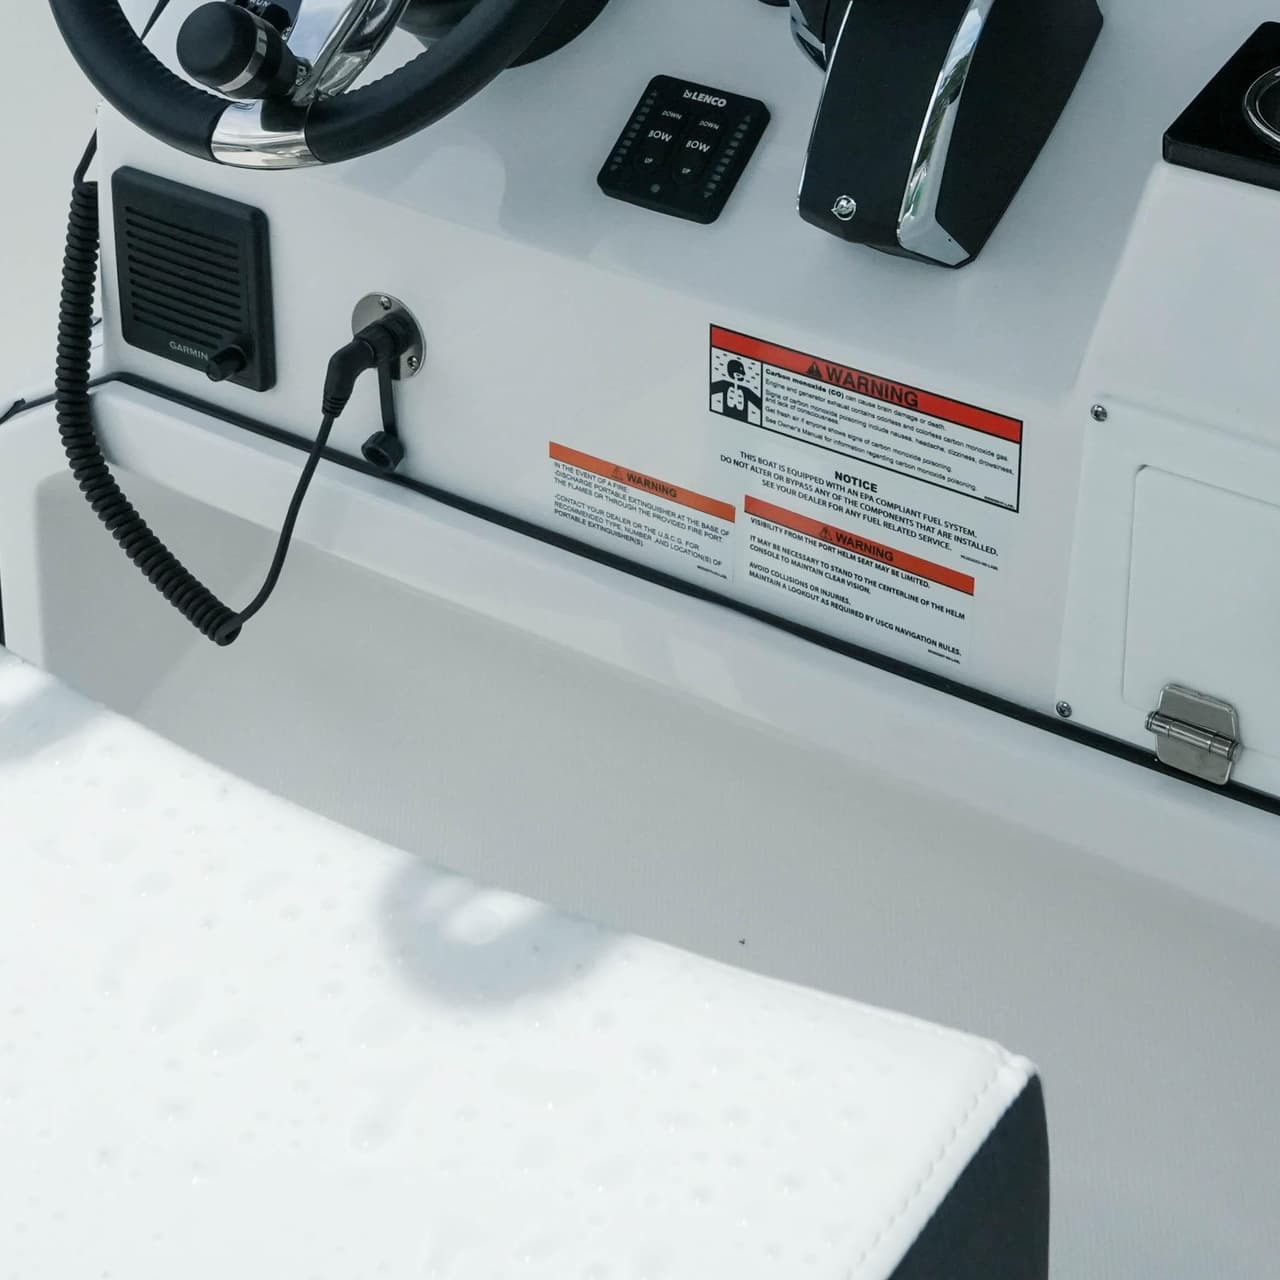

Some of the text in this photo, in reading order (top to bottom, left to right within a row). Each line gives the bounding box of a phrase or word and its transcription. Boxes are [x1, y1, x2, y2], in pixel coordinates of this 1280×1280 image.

[661, 110, 682, 120] DOWN
[691, 91, 727, 108] LENCO
[699, 120, 720, 130] DOWN
[169, 340, 209, 361] GARMIN
[825, 364, 919, 408] WARNING
[827, 388, 844, 398] (CO)
[626, 472, 678, 499] WARNING
[739, 450, 978, 538] THIS BOAT IS EQUIPPED WITH AN EPA COMPLIANT FUEL SYSTEM.
[834, 470, 878, 494] NOTICE
[553, 508, 586, 526] PORTABLE
[719, 454, 998, 556] DO NOT ALTER OR BYPASS ANY OF THE COMPONENTS THAT ARE INSTALLED.
[761, 478, 952, 551] SEE YOUR DEALER FOR ANY FUEL RELATED SERVICE.
[750, 517, 930, 589] VISIBILITY FROM THE PORT HELM SEAT MAY BE LIMITED.
[836, 532, 894, 561] WARNING
[749, 542, 871, 594] CONSOLE TO MAINTAIN CLEAR VISION.
[749, 534, 965, 620] IT MAY BE NECESSARY TO STAND TO THE CENTERLINE OF THE HELM
[749, 561, 851, 605] AVOID COLLISIONS OR INJURIES.
[748, 569, 962, 656] MAINTAIN A LOOKOUT AS REQUIRED BY USCG NAVIGATION RULES.
